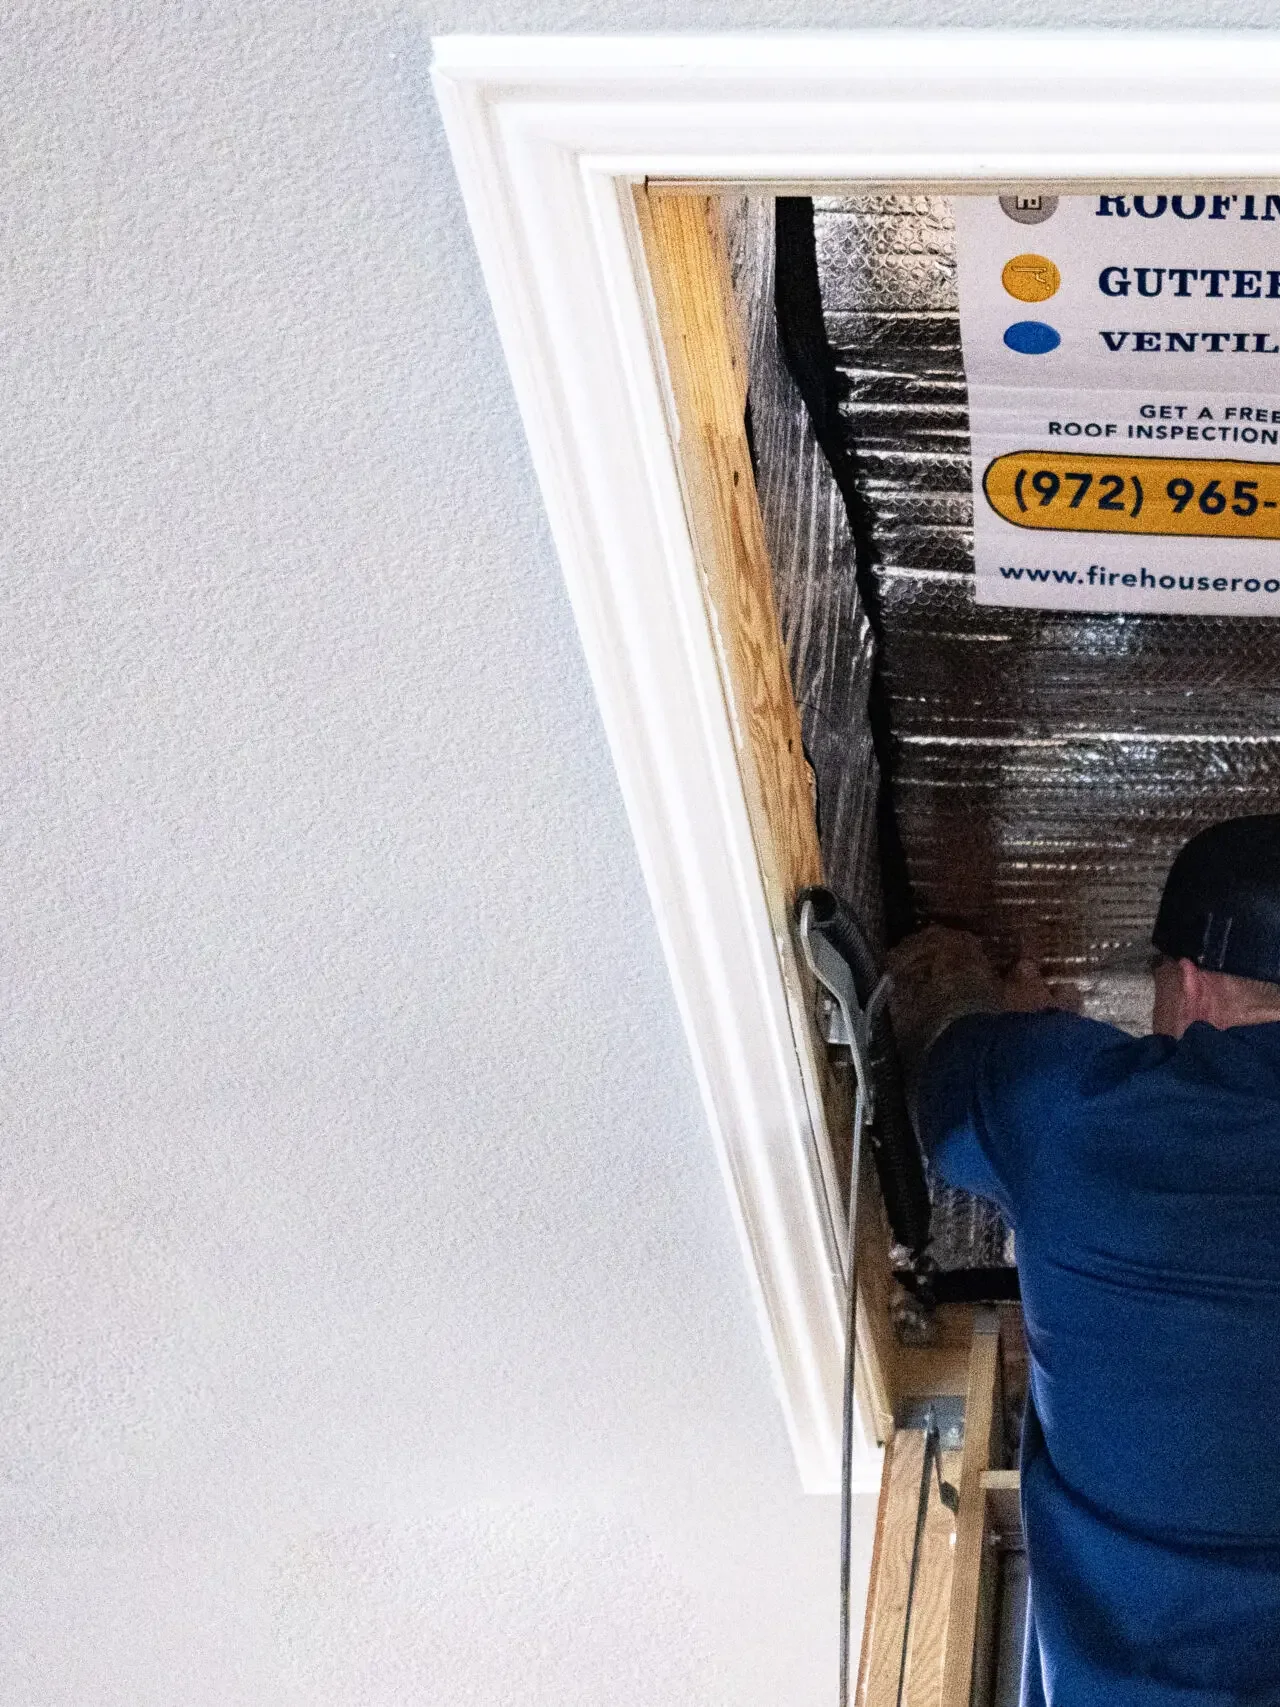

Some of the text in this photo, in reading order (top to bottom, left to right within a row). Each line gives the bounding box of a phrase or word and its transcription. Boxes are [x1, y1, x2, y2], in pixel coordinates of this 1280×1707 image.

[1140, 404, 1187, 420] GET
[1198, 406, 1214, 420] A
[1049, 421, 1118, 438] ROOF
[1128, 424, 1279, 445] INSPECTION
[1014, 469, 1144, 518] (972)
